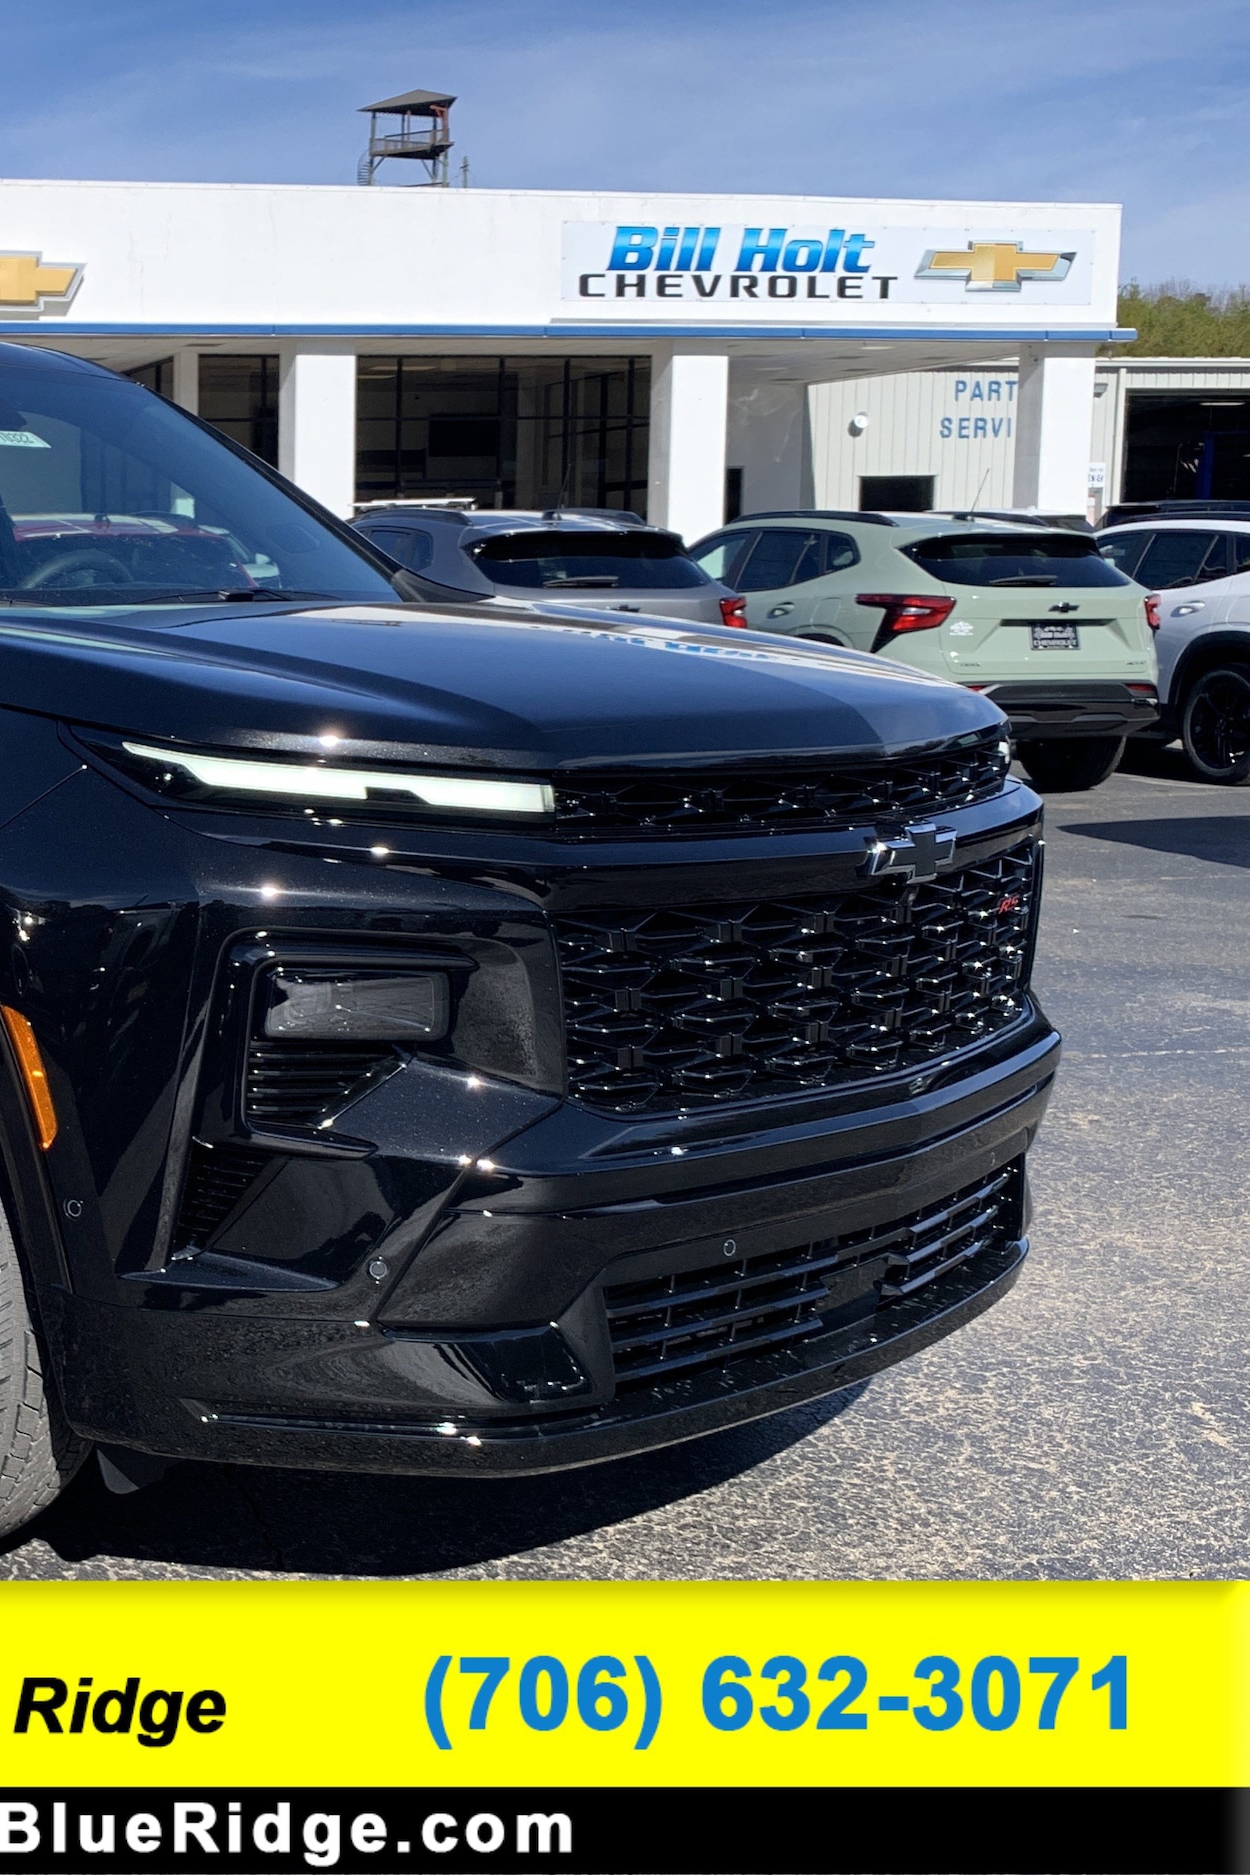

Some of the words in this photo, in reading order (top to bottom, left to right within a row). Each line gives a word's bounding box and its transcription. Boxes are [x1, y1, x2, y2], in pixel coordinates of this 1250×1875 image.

[606, 226, 722, 272] Bill
[734, 227, 876, 273] Holt
[578, 273, 899, 299] CHEVROLET
